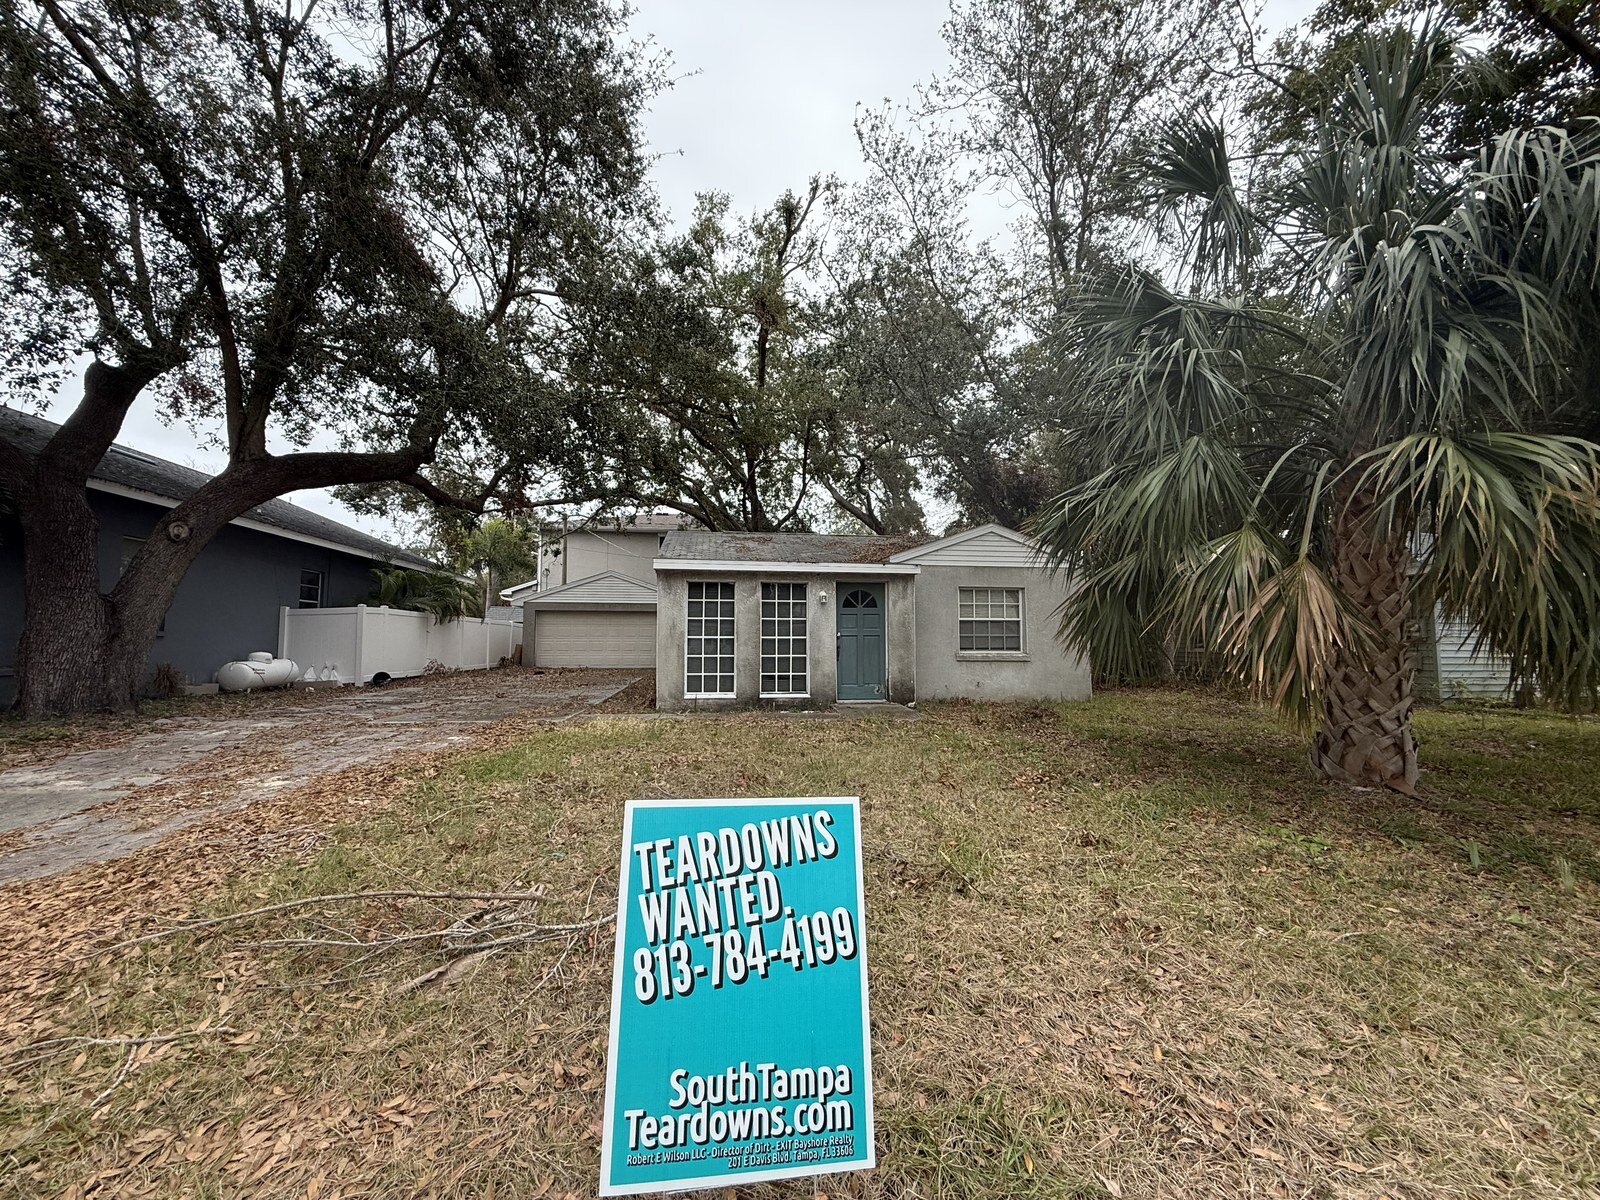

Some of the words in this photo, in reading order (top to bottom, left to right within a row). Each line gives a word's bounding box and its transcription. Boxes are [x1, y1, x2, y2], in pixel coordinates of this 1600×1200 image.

[633, 809, 837, 891] TEARDOWNS
[638, 871, 794, 946] WANTED.
[633, 906, 857, 1004] 813-784-4199
[624, 1099, 853, 1150] Teardowns.com
[627, 1154, 655, 1166] Robert
[656, 1153, 662, 1163] E
[663, 1151, 690, 1162] Wilson
[692, 1148, 706, 1159] LLC
[711, 1146, 743, 1158] Director
[745, 1143, 754, 1154] of
[755, 1142, 770, 1153] Dirt
[776, 1140, 792, 1151] EXIT
[795, 1137, 828, 1151] Bayshore
[829, 1134, 853, 1146] Realty
[728, 1157, 741, 1168] 201
[744, 1156, 749, 1167] E
[750, 1154, 770, 1166] Davis
[773, 1151, 792, 1164] Blvd.
[793, 1149, 820, 1162] Tampa,
[822, 1147, 830, 1159] FL
[832, 1145, 854, 1157] 33606
